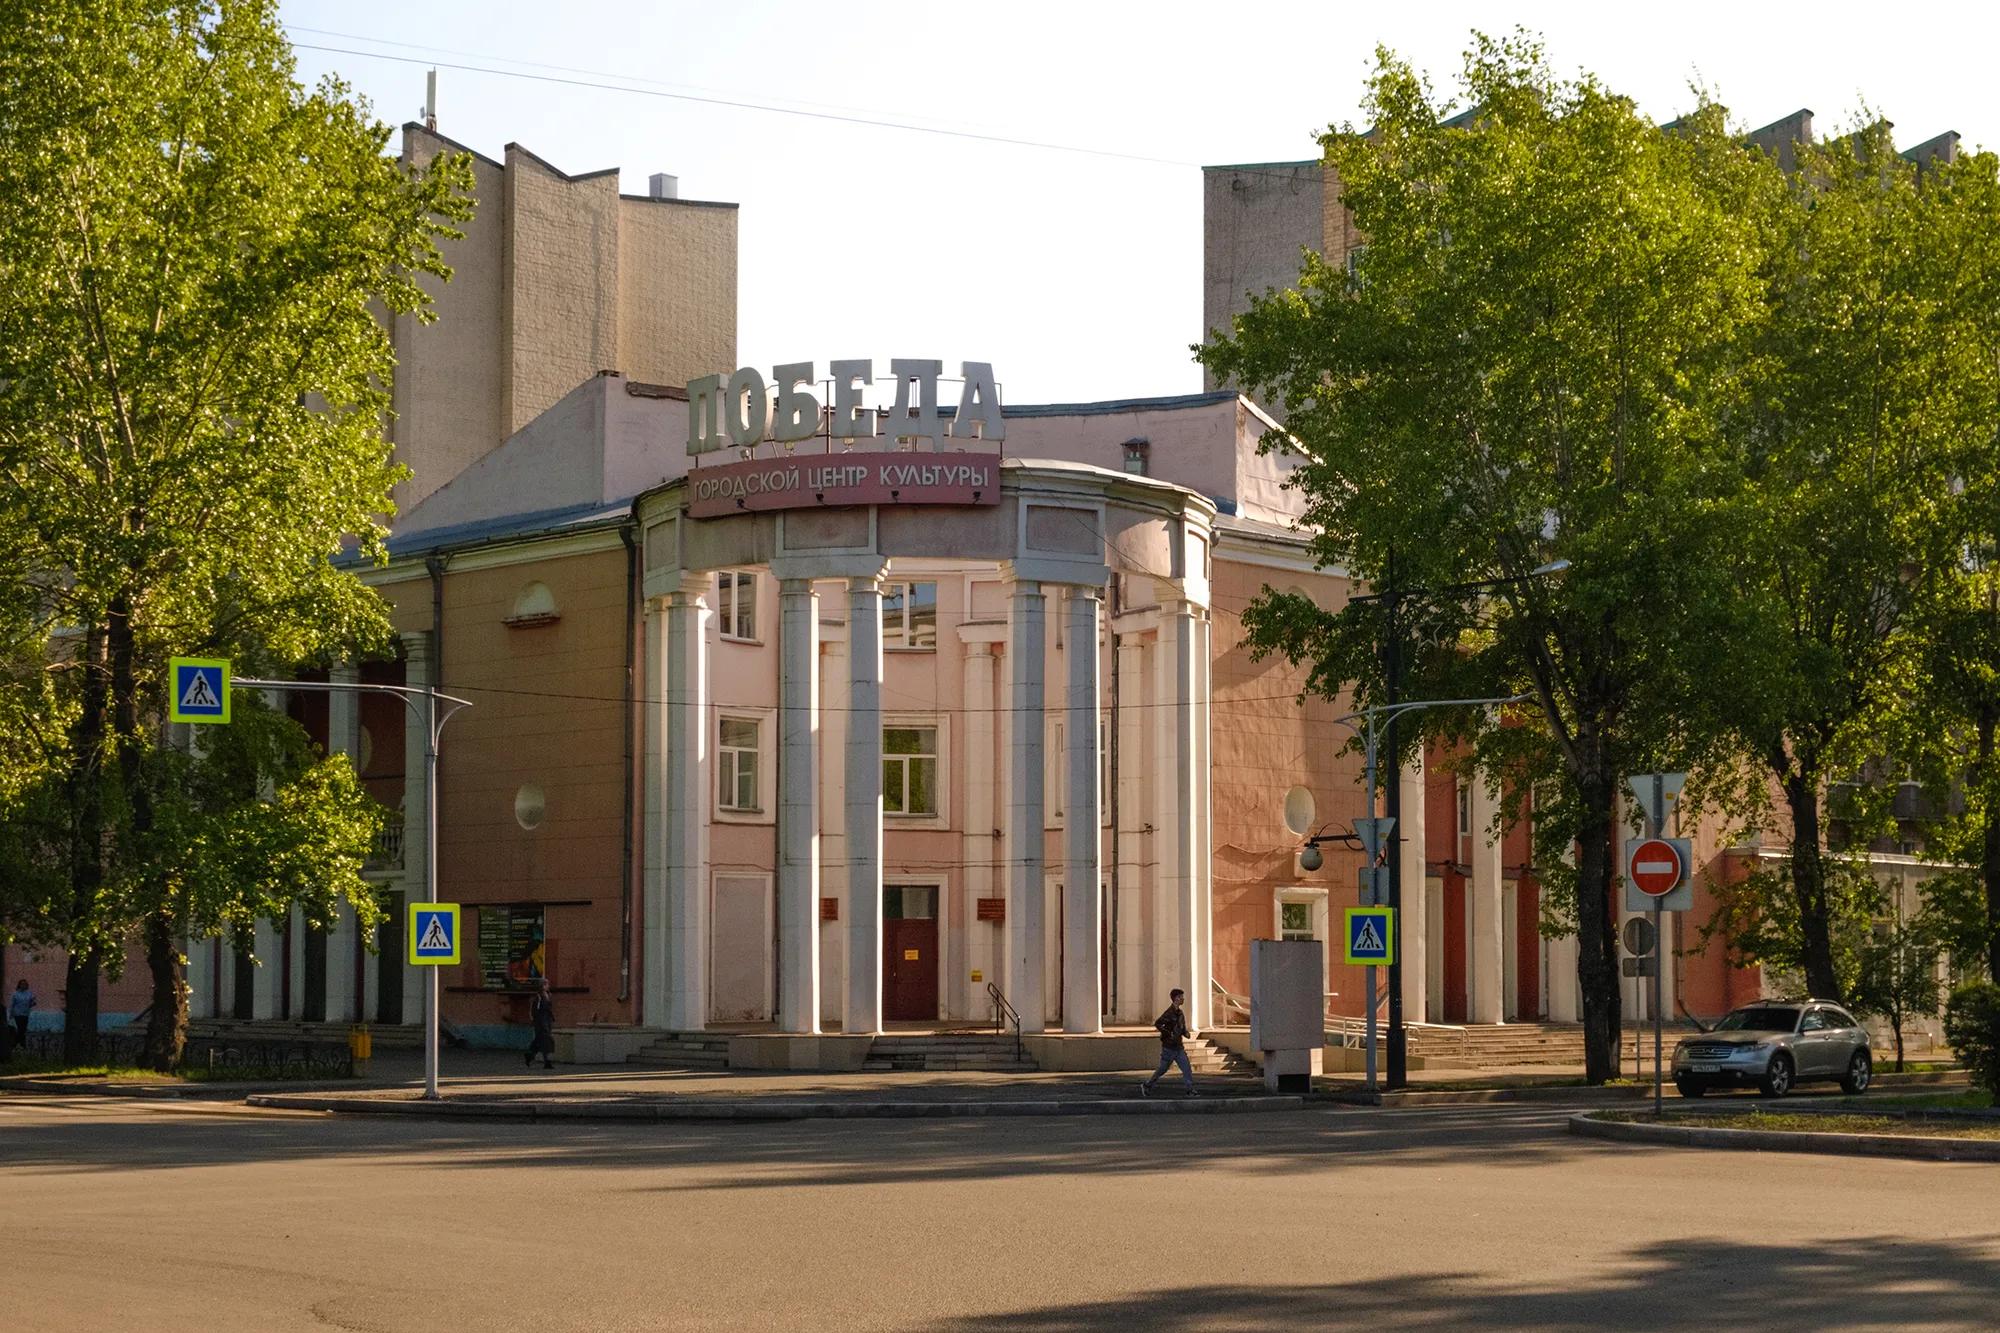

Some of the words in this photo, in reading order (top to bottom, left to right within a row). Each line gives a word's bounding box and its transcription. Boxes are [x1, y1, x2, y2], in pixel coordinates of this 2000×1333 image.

[687, 359, 1005, 456] ПОБЕДА
[694, 465, 799, 501] ГОРОДСКОЙ
[808, 466, 868, 490] ЦЕНТР
[880, 465, 988, 487] КУЛЬТУРЫ
